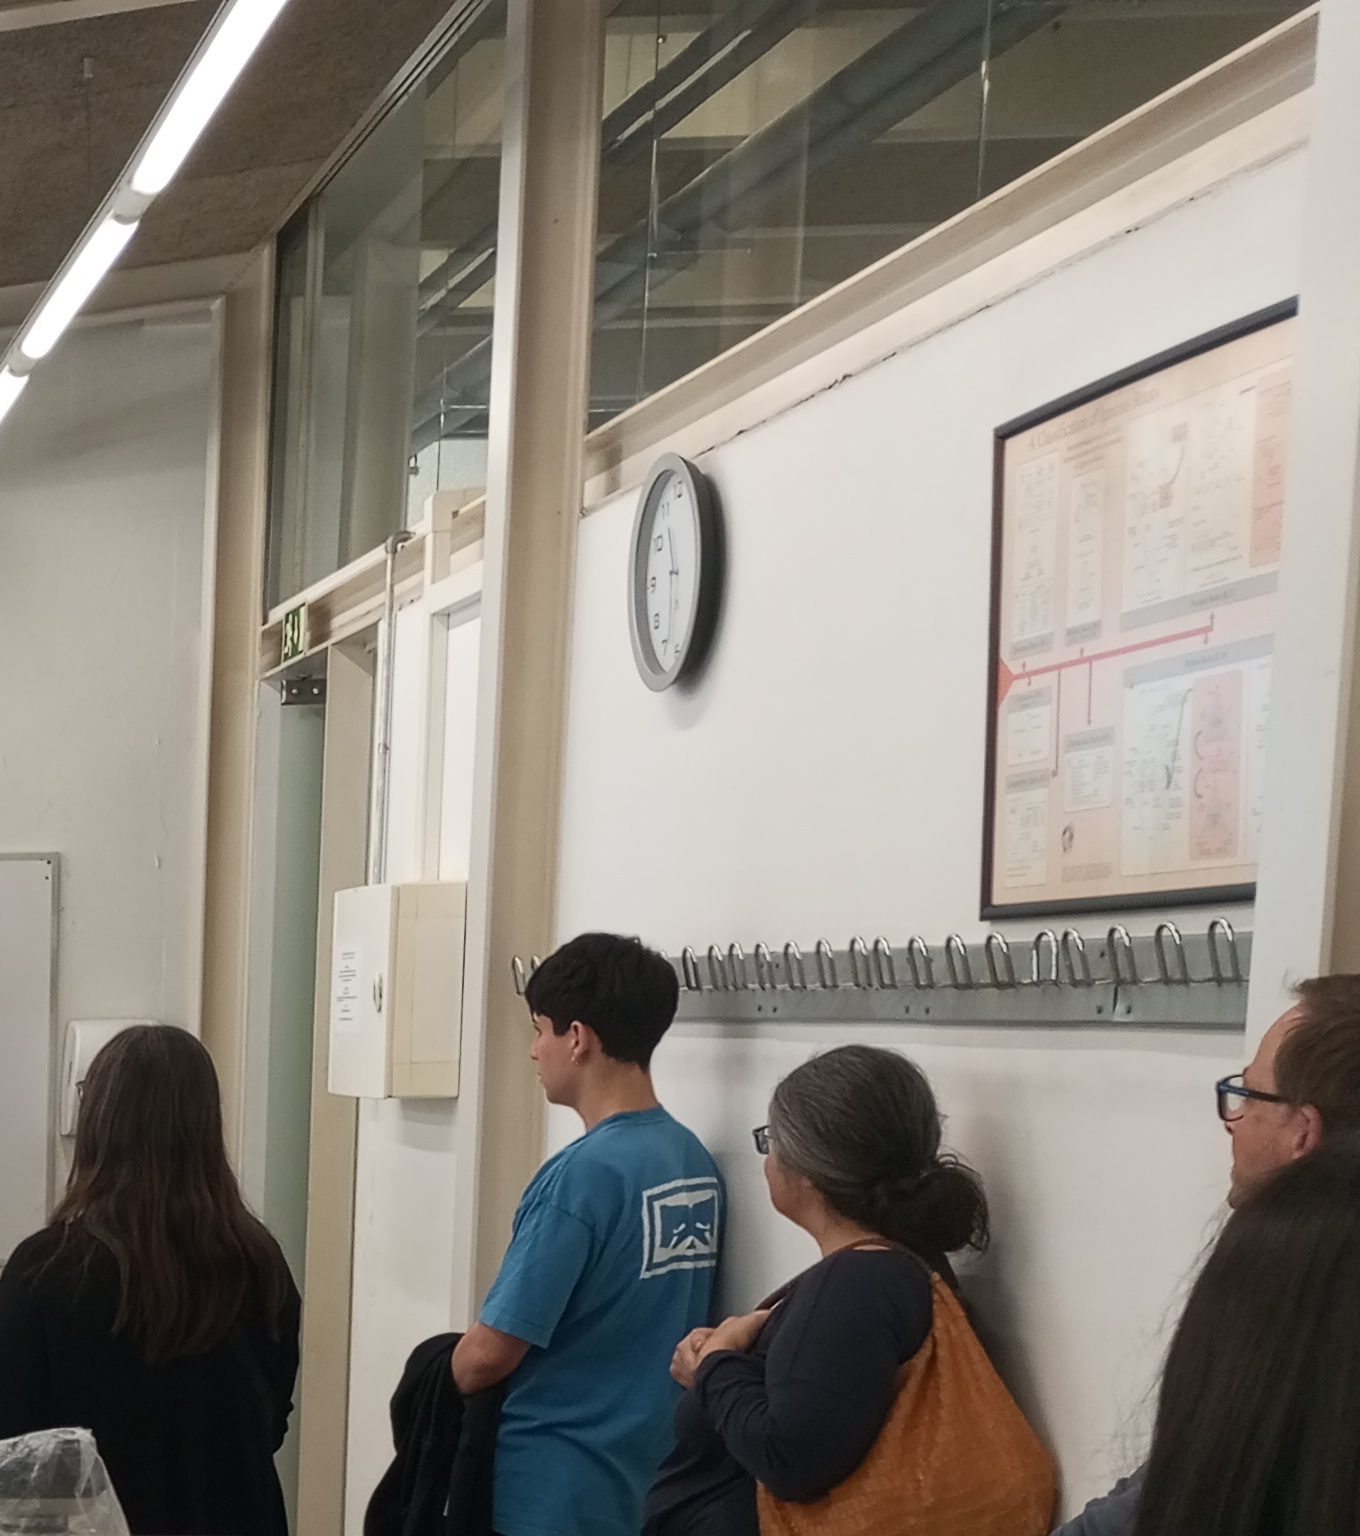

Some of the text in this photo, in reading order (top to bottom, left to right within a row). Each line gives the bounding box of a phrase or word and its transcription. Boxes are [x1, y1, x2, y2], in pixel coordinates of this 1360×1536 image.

[673, 480, 683, 499] 12
[661, 502, 670, 519] 11
[654, 535, 664, 552] 10
[649, 576, 657, 594] 9
[653, 612, 660, 630] 8
[661, 639, 668, 656] 7
